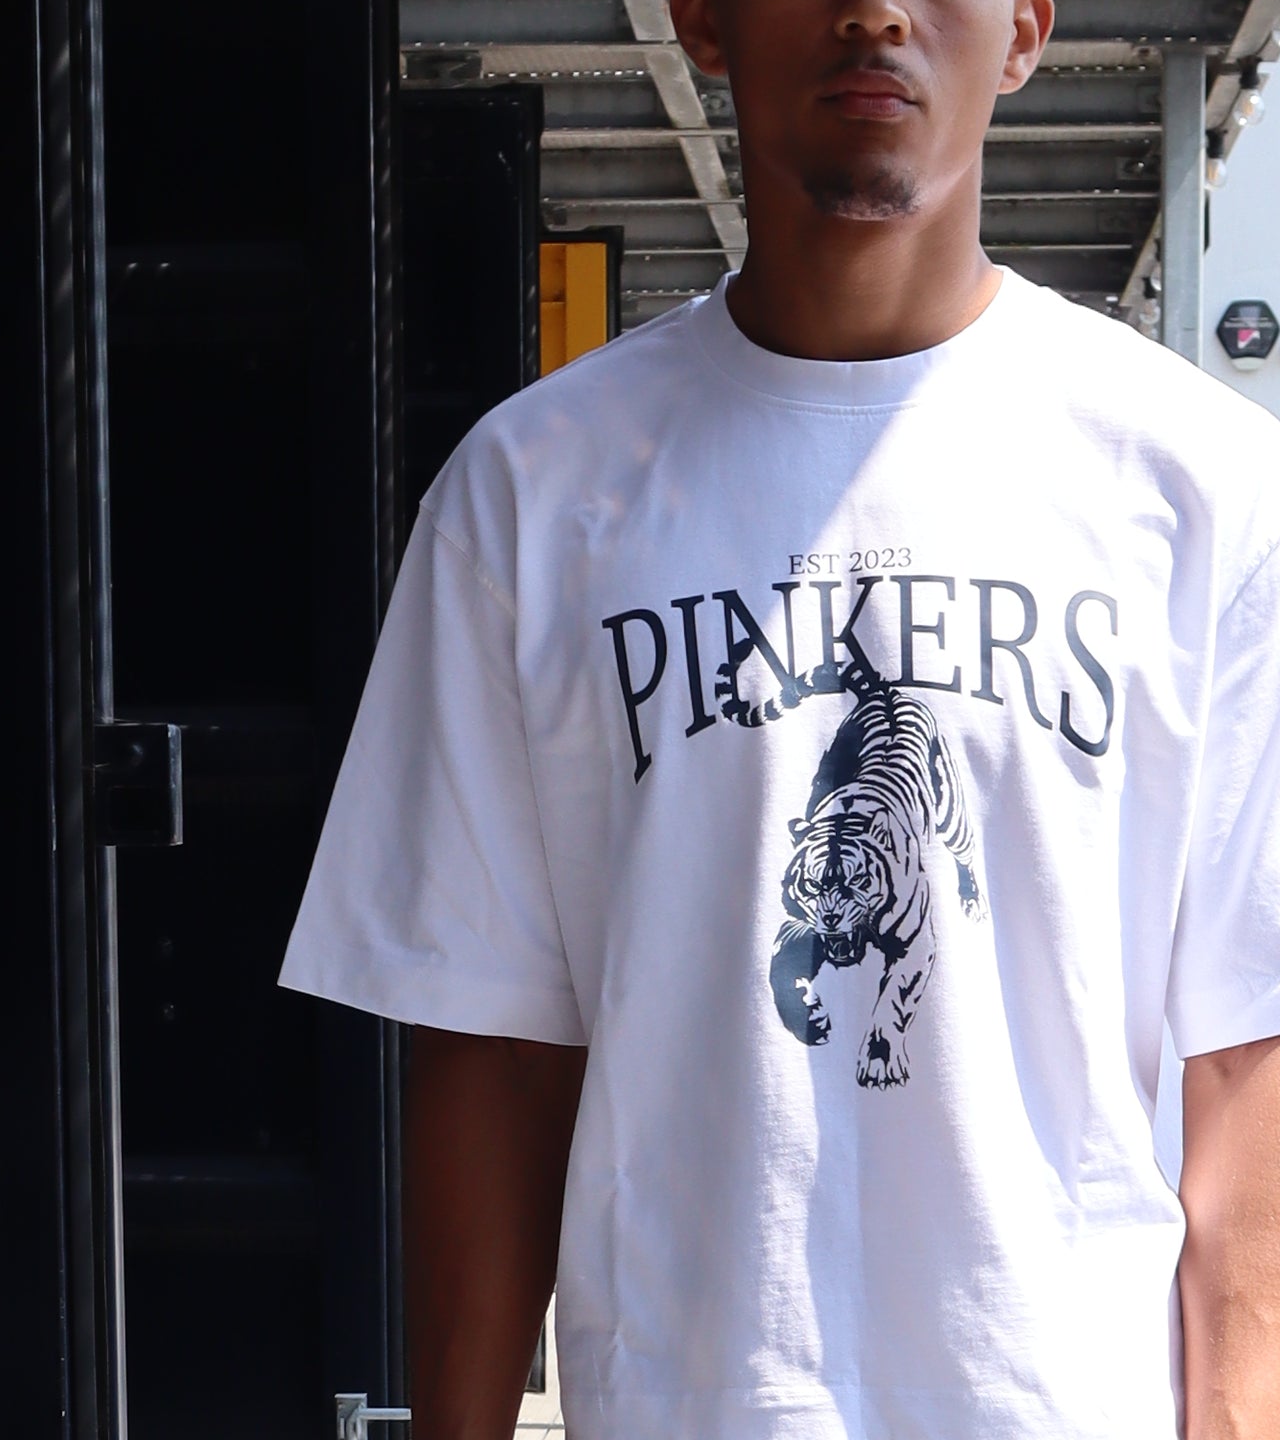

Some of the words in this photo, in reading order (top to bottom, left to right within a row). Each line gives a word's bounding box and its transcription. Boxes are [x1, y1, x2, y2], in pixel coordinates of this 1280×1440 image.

[788, 553, 840, 575] EST
[849, 547, 912, 572] 2023
[602, 575, 1118, 785] PINKERS
